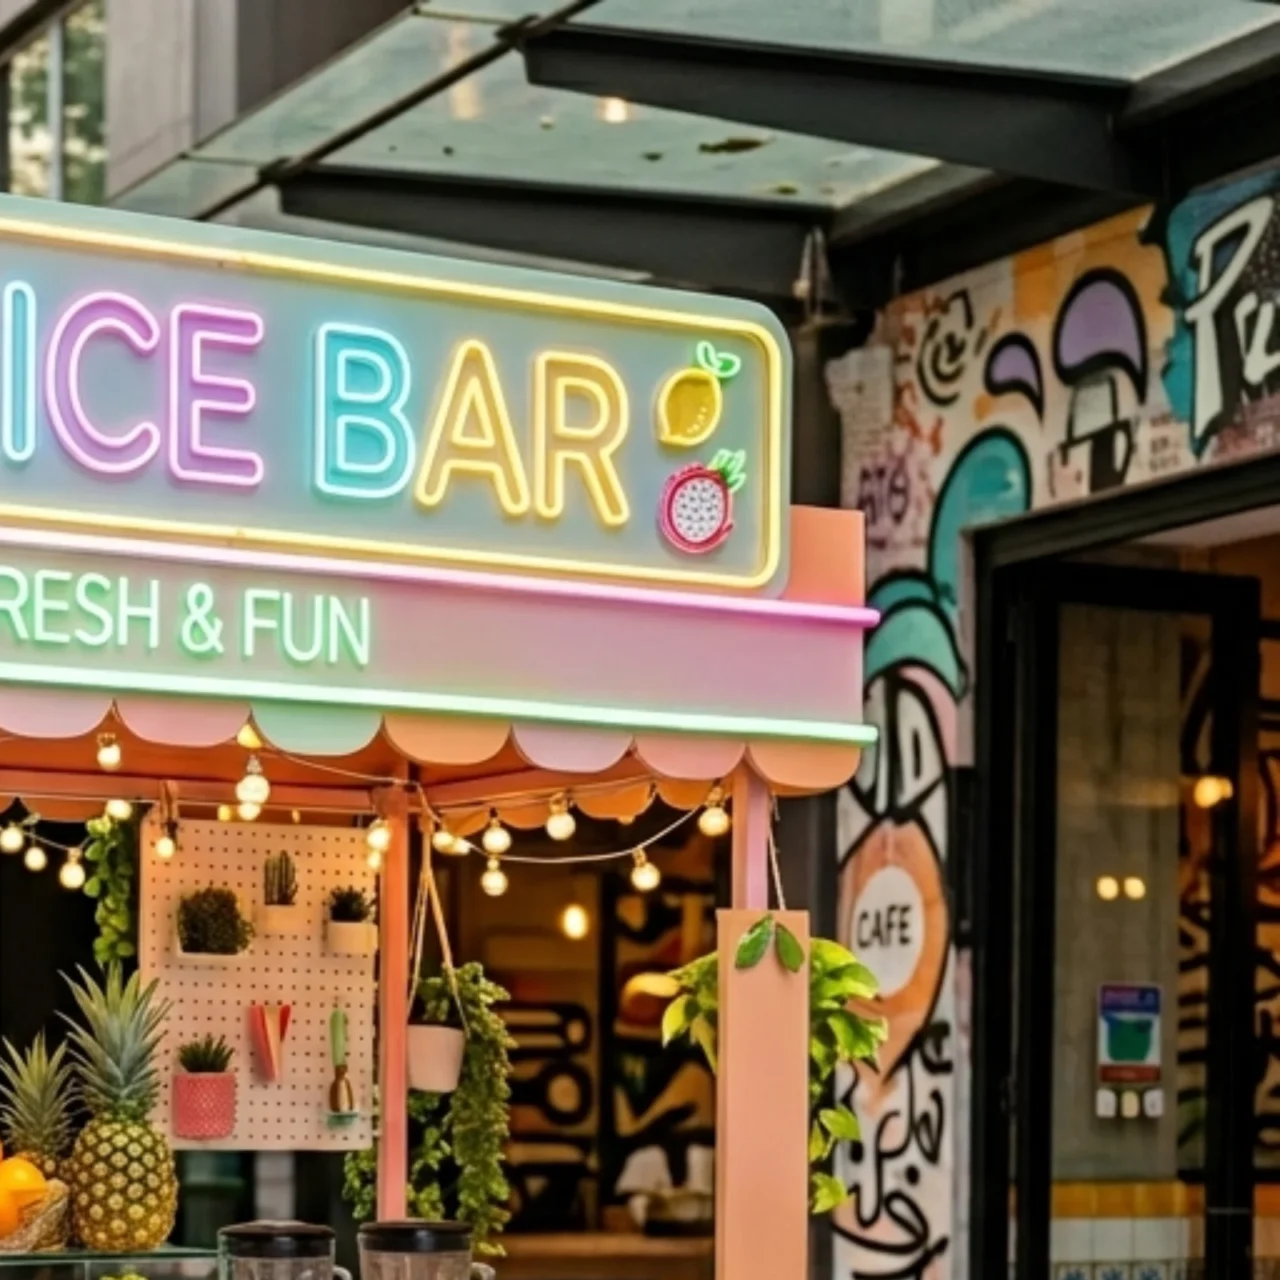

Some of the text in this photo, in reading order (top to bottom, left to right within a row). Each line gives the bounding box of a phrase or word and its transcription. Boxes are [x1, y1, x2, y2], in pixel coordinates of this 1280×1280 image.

[314, 321, 631, 527] BAR
[181, 582, 225, 654] &
[243, 588, 369, 665] FUN
[856, 904, 913, 949] CAFE
